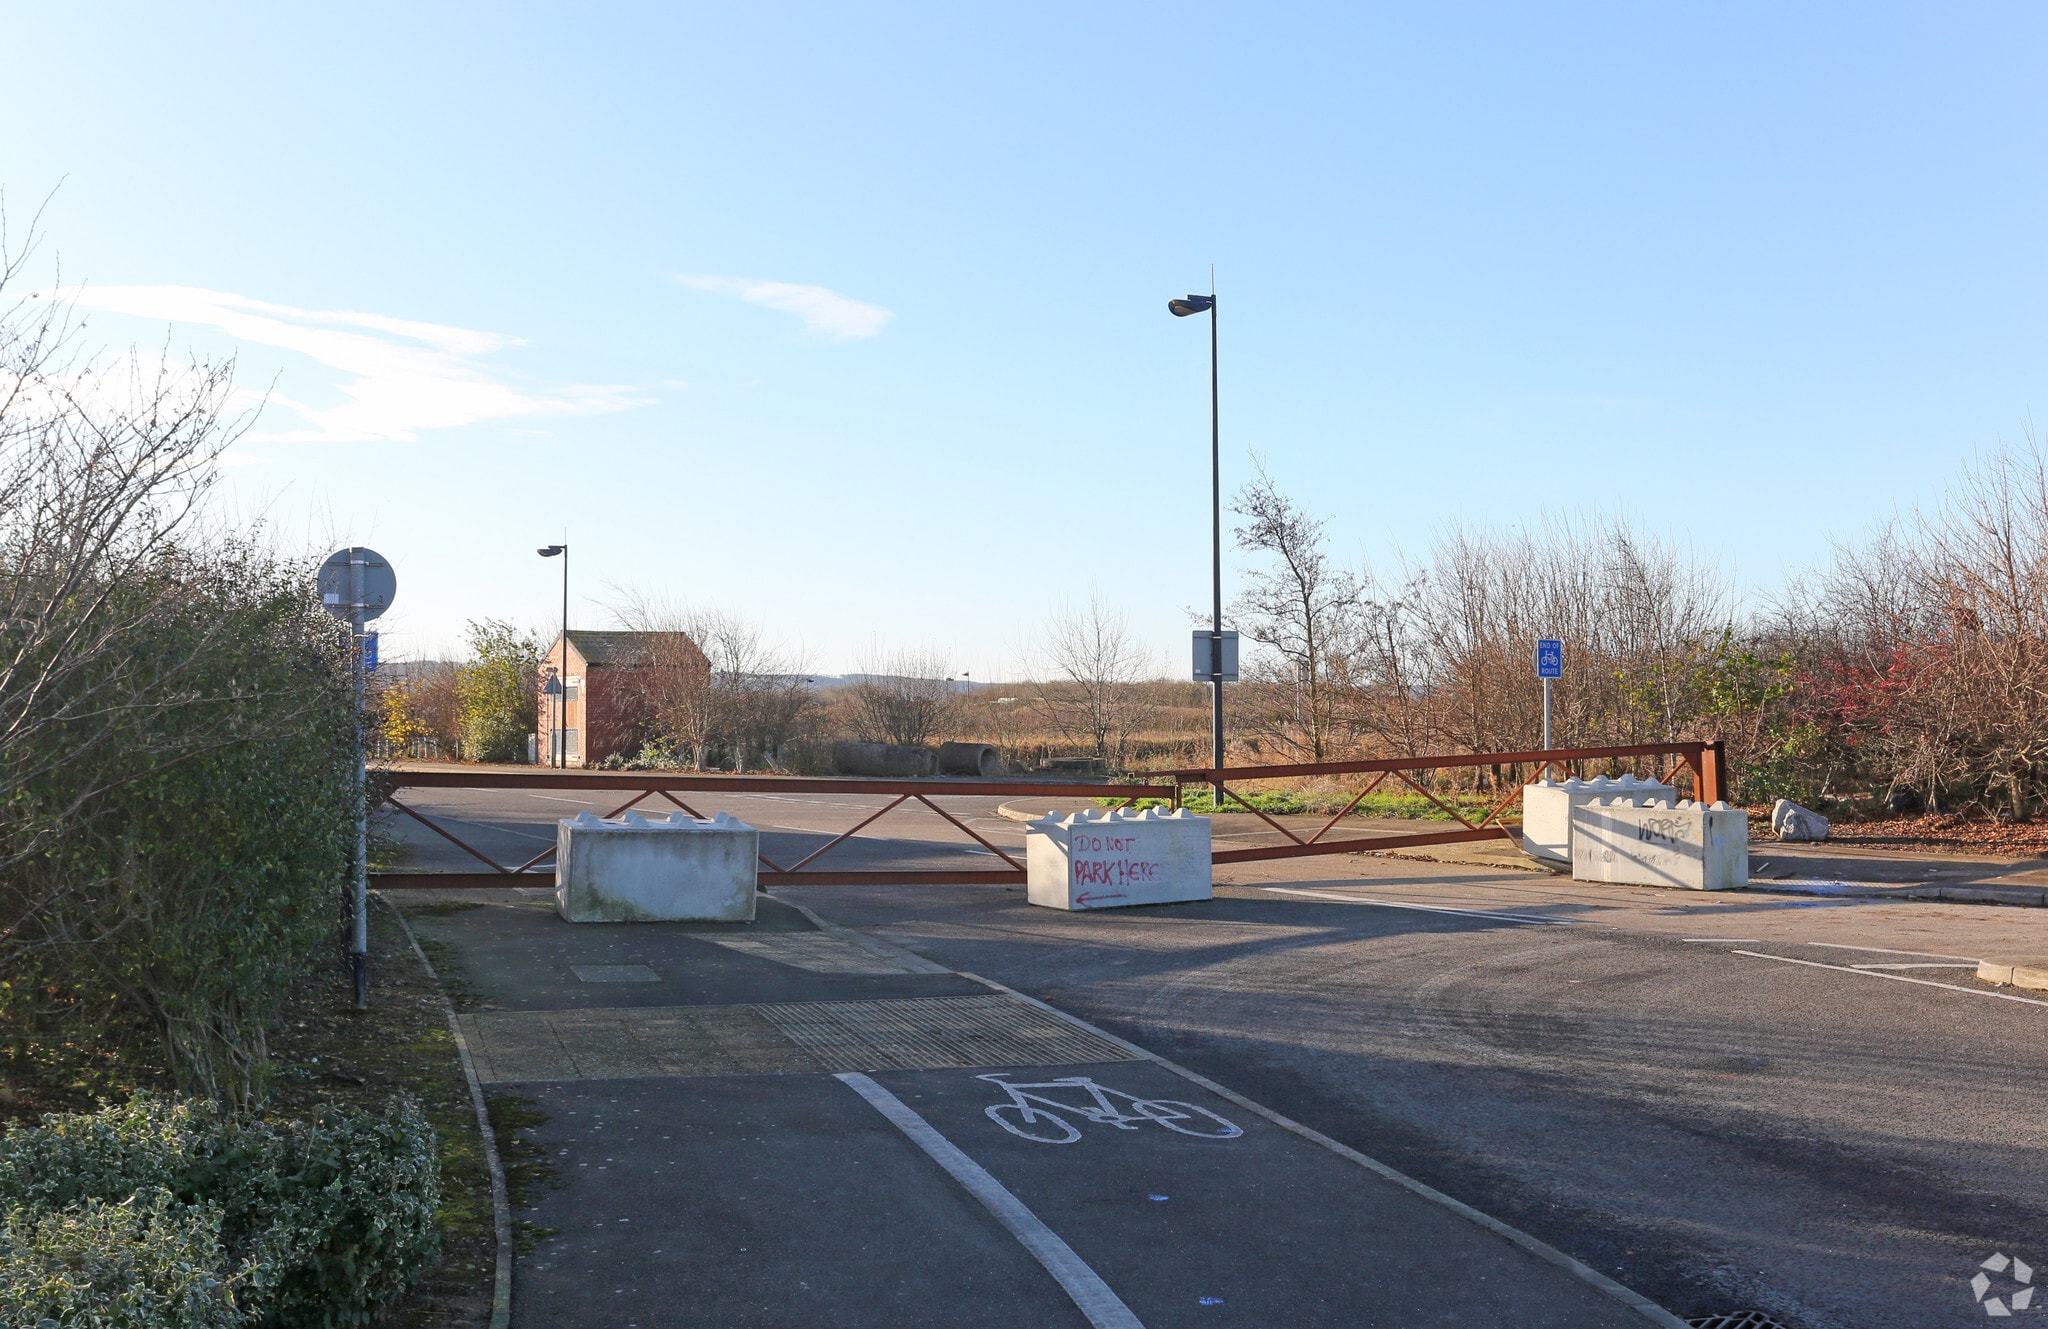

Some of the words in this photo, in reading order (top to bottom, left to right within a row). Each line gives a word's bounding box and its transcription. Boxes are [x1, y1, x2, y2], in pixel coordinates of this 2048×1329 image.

[1541, 667, 1559, 675] ROUTE
[1075, 835, 1102, 852] DO
[1106, 836, 1136, 852] NOT
[1074, 859, 1115, 886] PARK
[1117, 859, 1162, 886] HERE
